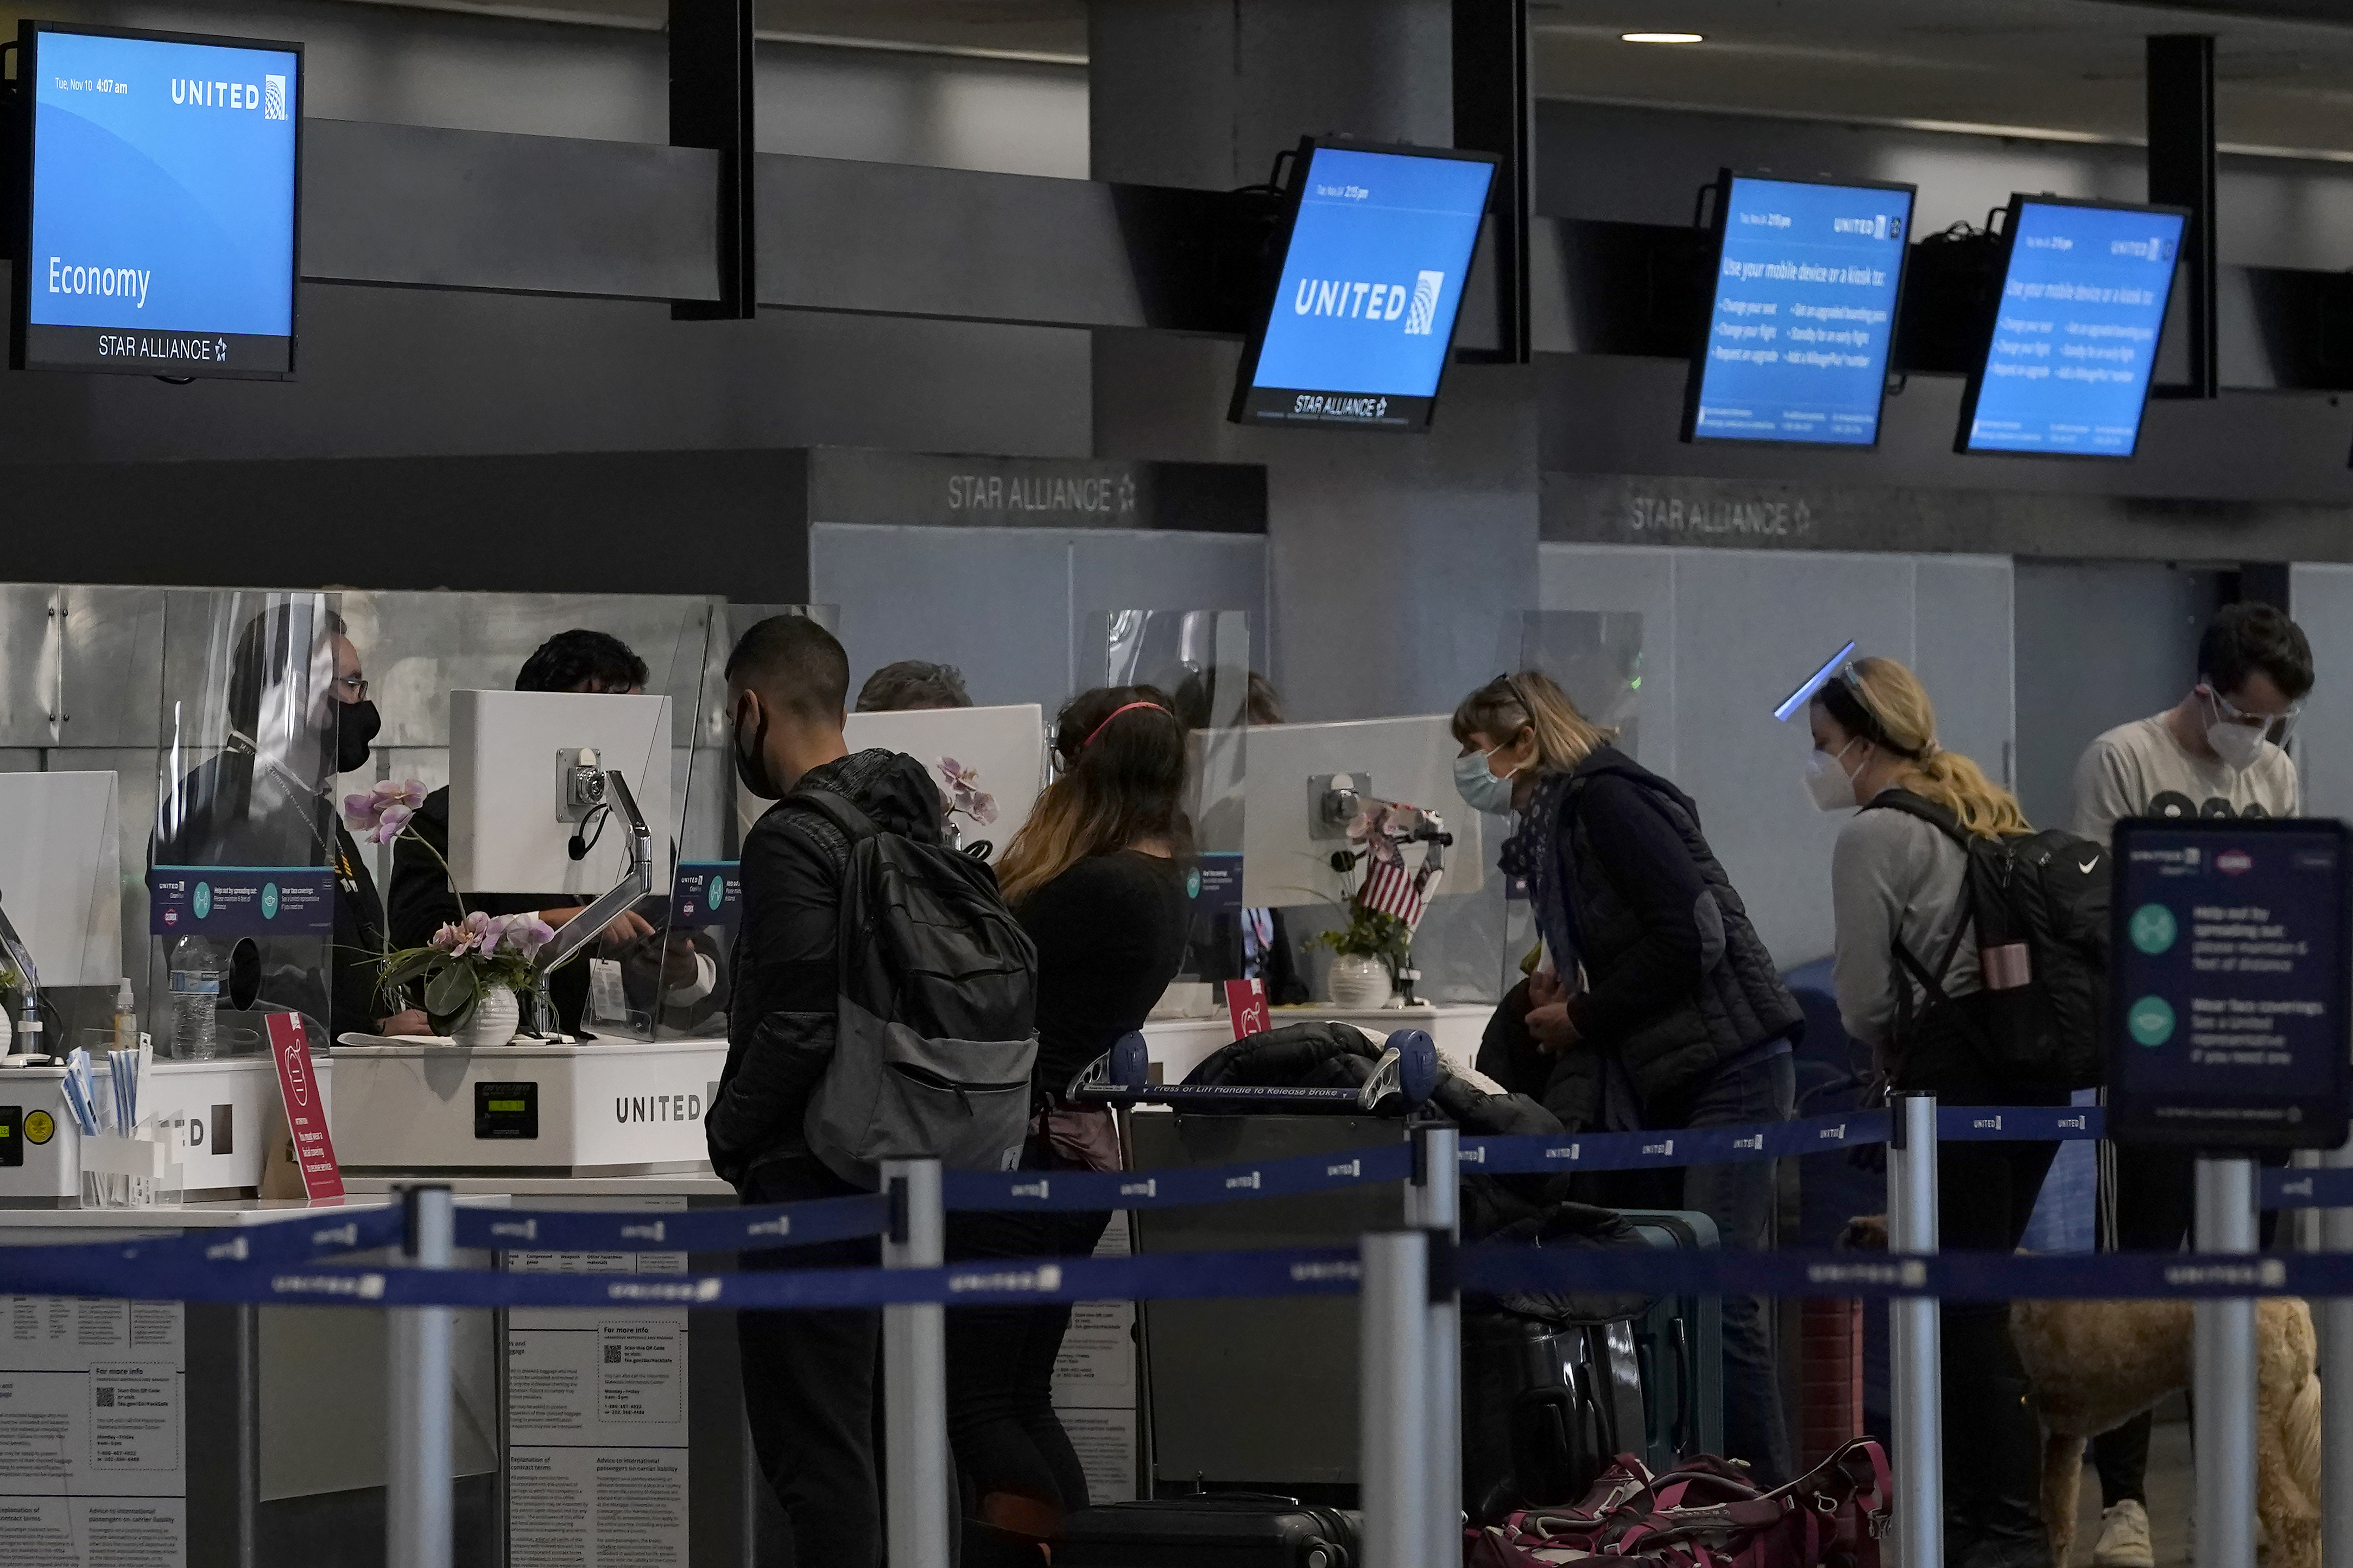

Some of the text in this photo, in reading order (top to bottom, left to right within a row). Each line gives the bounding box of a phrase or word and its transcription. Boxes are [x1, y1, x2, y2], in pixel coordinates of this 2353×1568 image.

[55, 78, 128, 94] Tue, Nov 10 4:07 am
[171, 78, 259, 110] UNITED
[49, 257, 150, 308] Economy
[1295, 278, 1406, 321] UNITED
[98, 335, 210, 360] STAR ALLIANCE
[1294, 395, 1377, 417] STAR ALLIANCE
[948, 475, 1112, 511] STAR ALLIANCE
[1631, 497, 1788, 535] STAR ALLIANCE
[616, 1095, 701, 1123] UNITED
[2058, 1119, 2079, 1127] UNITED
[1974, 1120, 1995, 1128] UNITED
